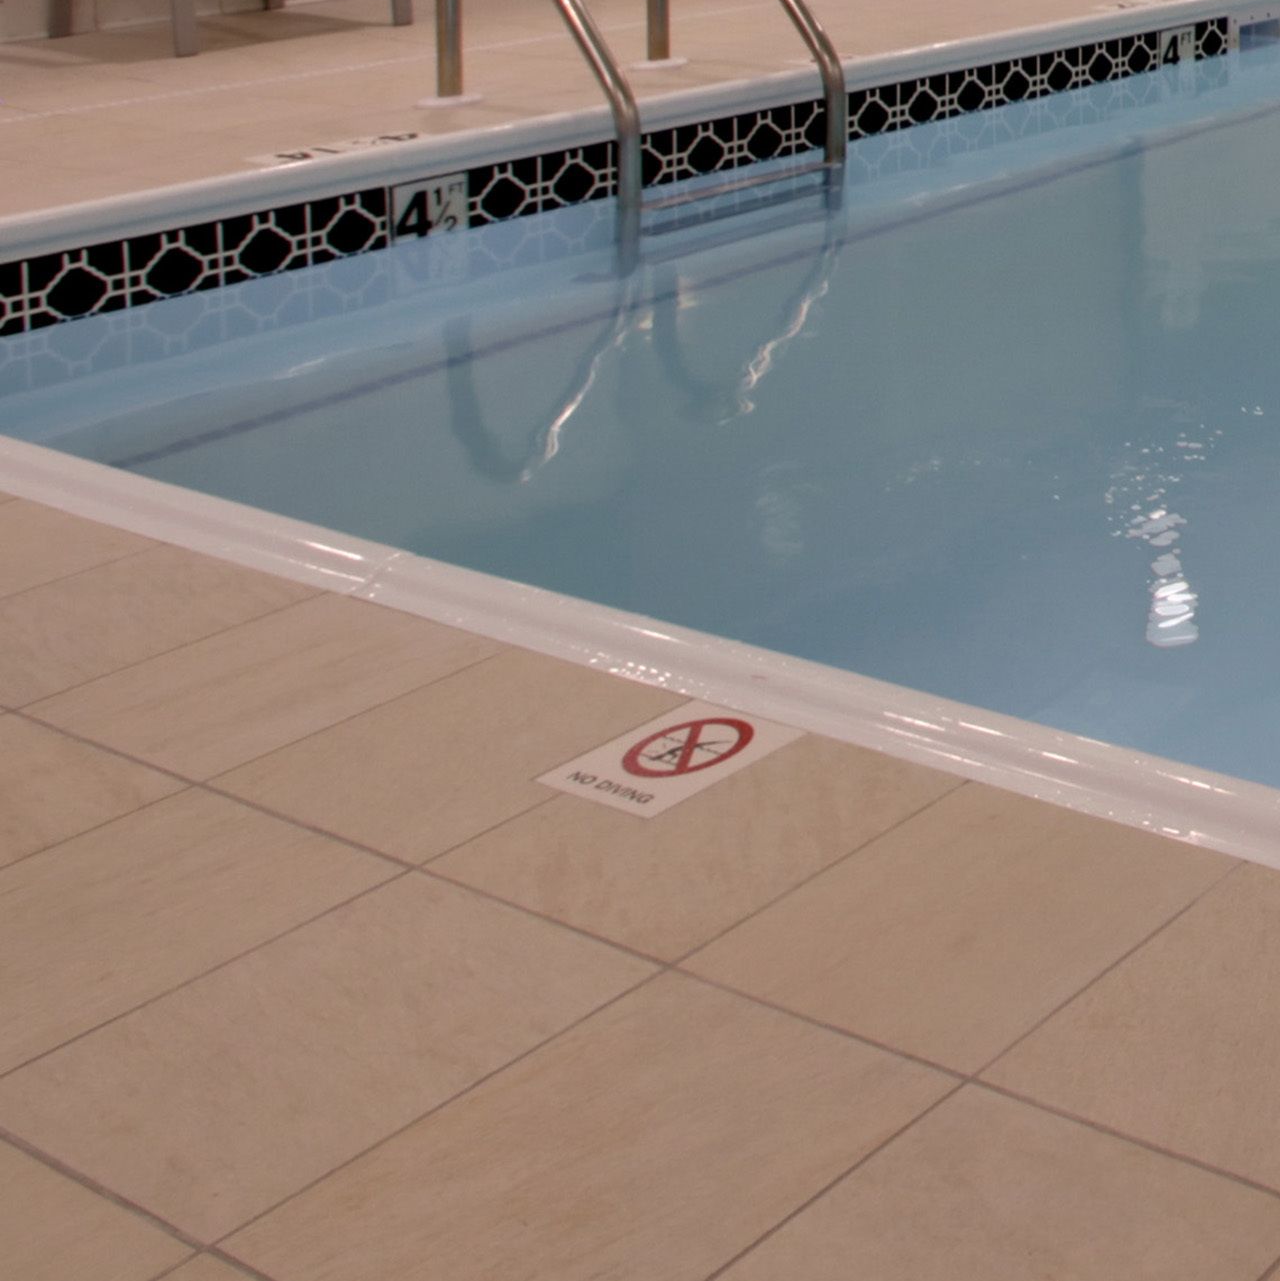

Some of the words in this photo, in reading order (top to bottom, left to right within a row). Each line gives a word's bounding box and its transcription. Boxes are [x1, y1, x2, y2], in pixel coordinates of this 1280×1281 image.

[1162, 34, 1180, 65] 4
[566, 771, 598, 785] NO
[594, 779, 656, 804] DIVING
